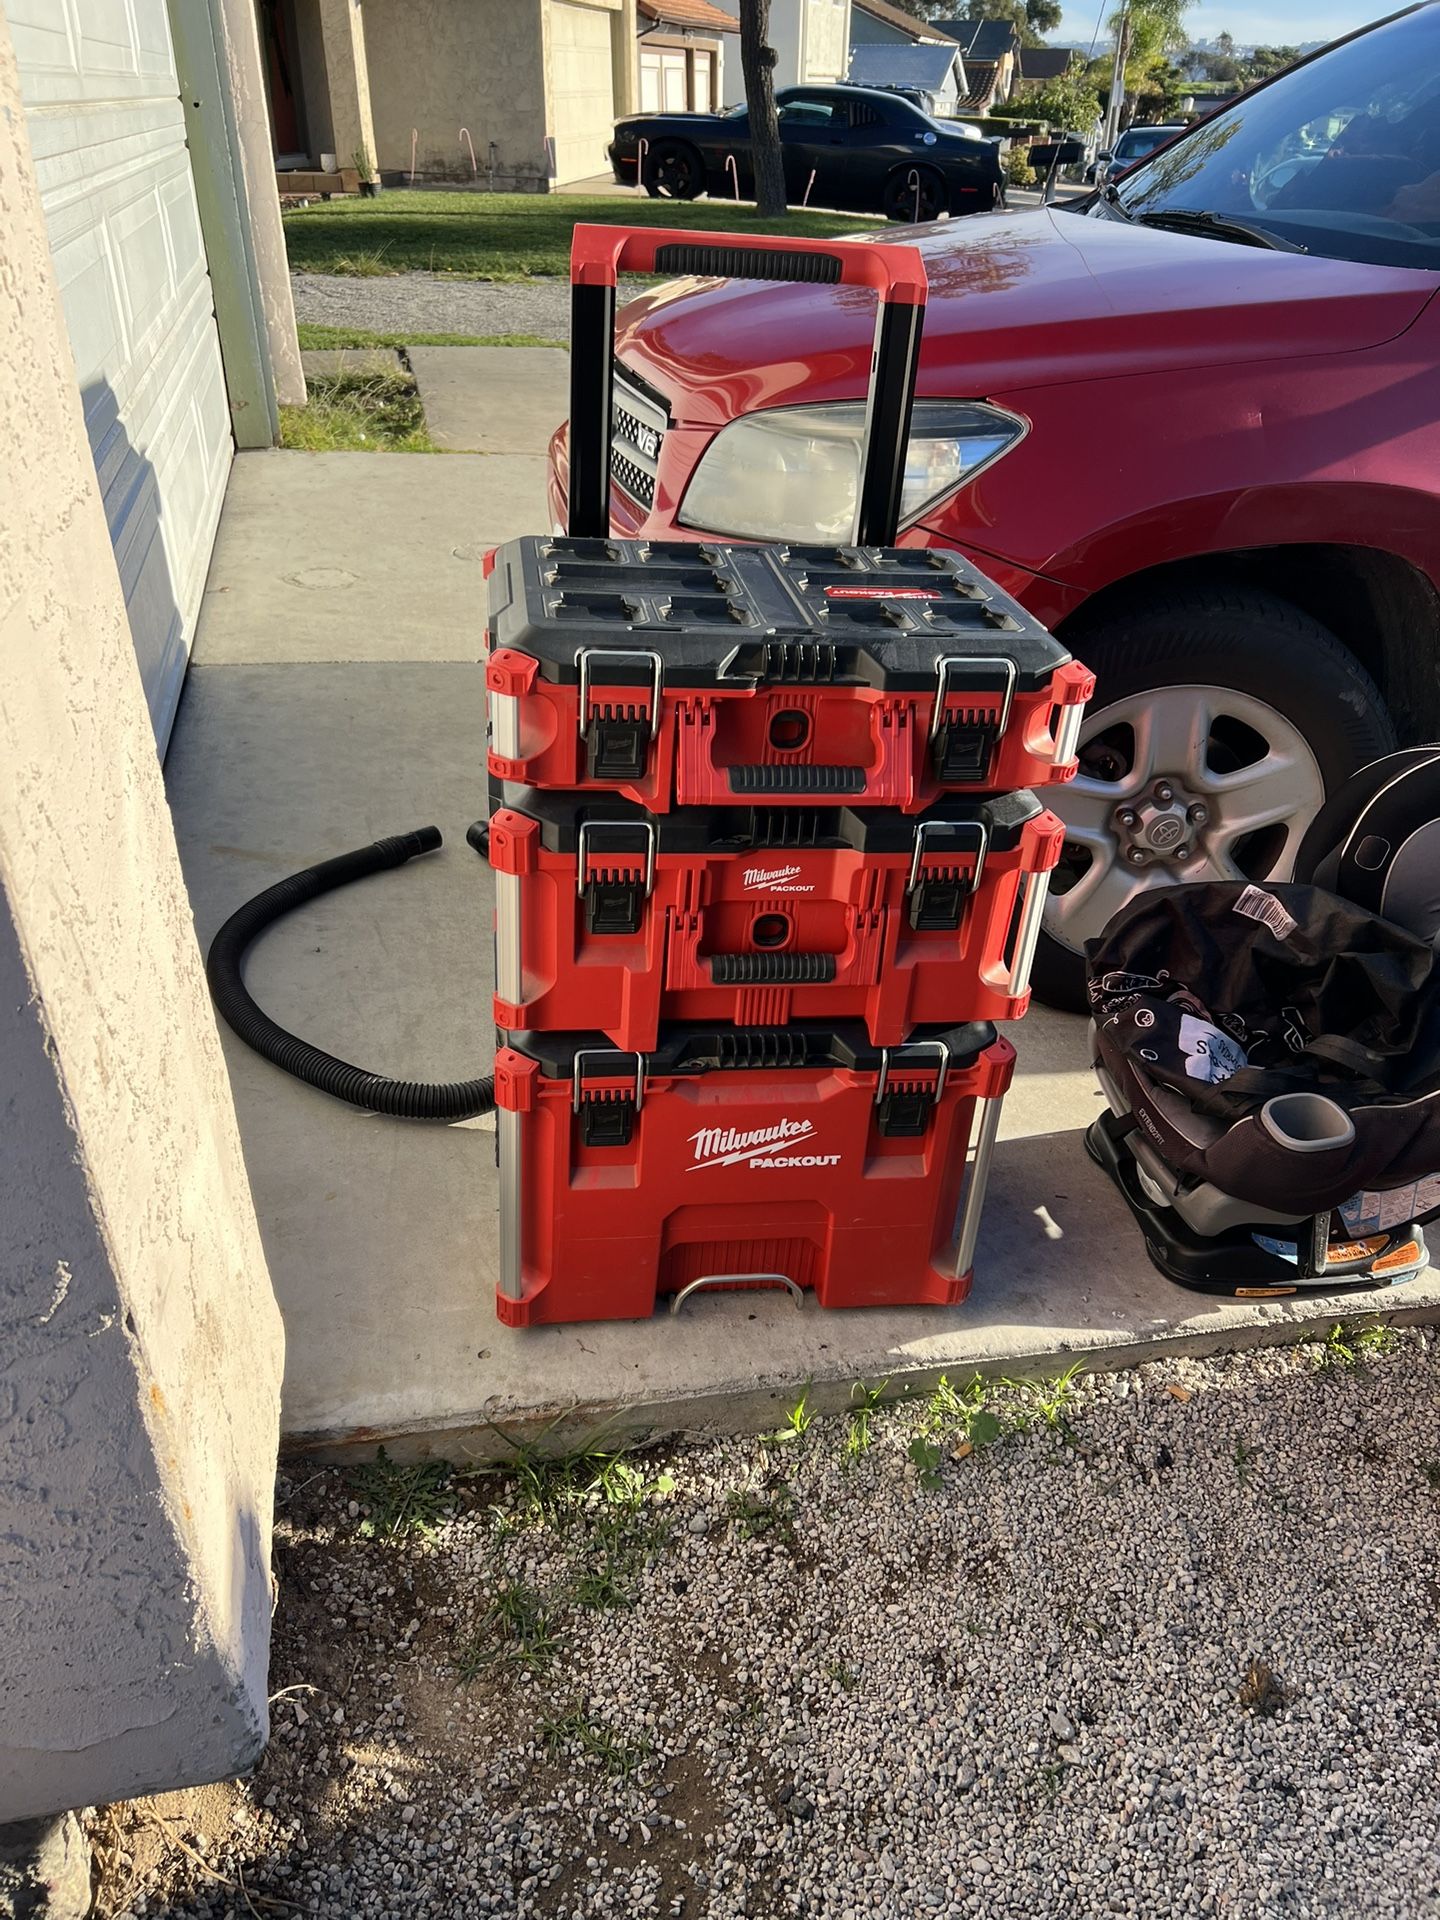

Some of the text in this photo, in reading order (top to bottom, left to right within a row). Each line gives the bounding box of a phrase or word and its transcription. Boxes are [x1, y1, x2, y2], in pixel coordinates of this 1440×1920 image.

[637, 423, 658, 459] V6
[742, 864, 801, 886] Milwaukee
[686, 1117, 814, 1161] Milwaukee
[1138, 1107, 1165, 1145] EXTEND2FIT
[750, 1154, 842, 1169] PACKOUT
